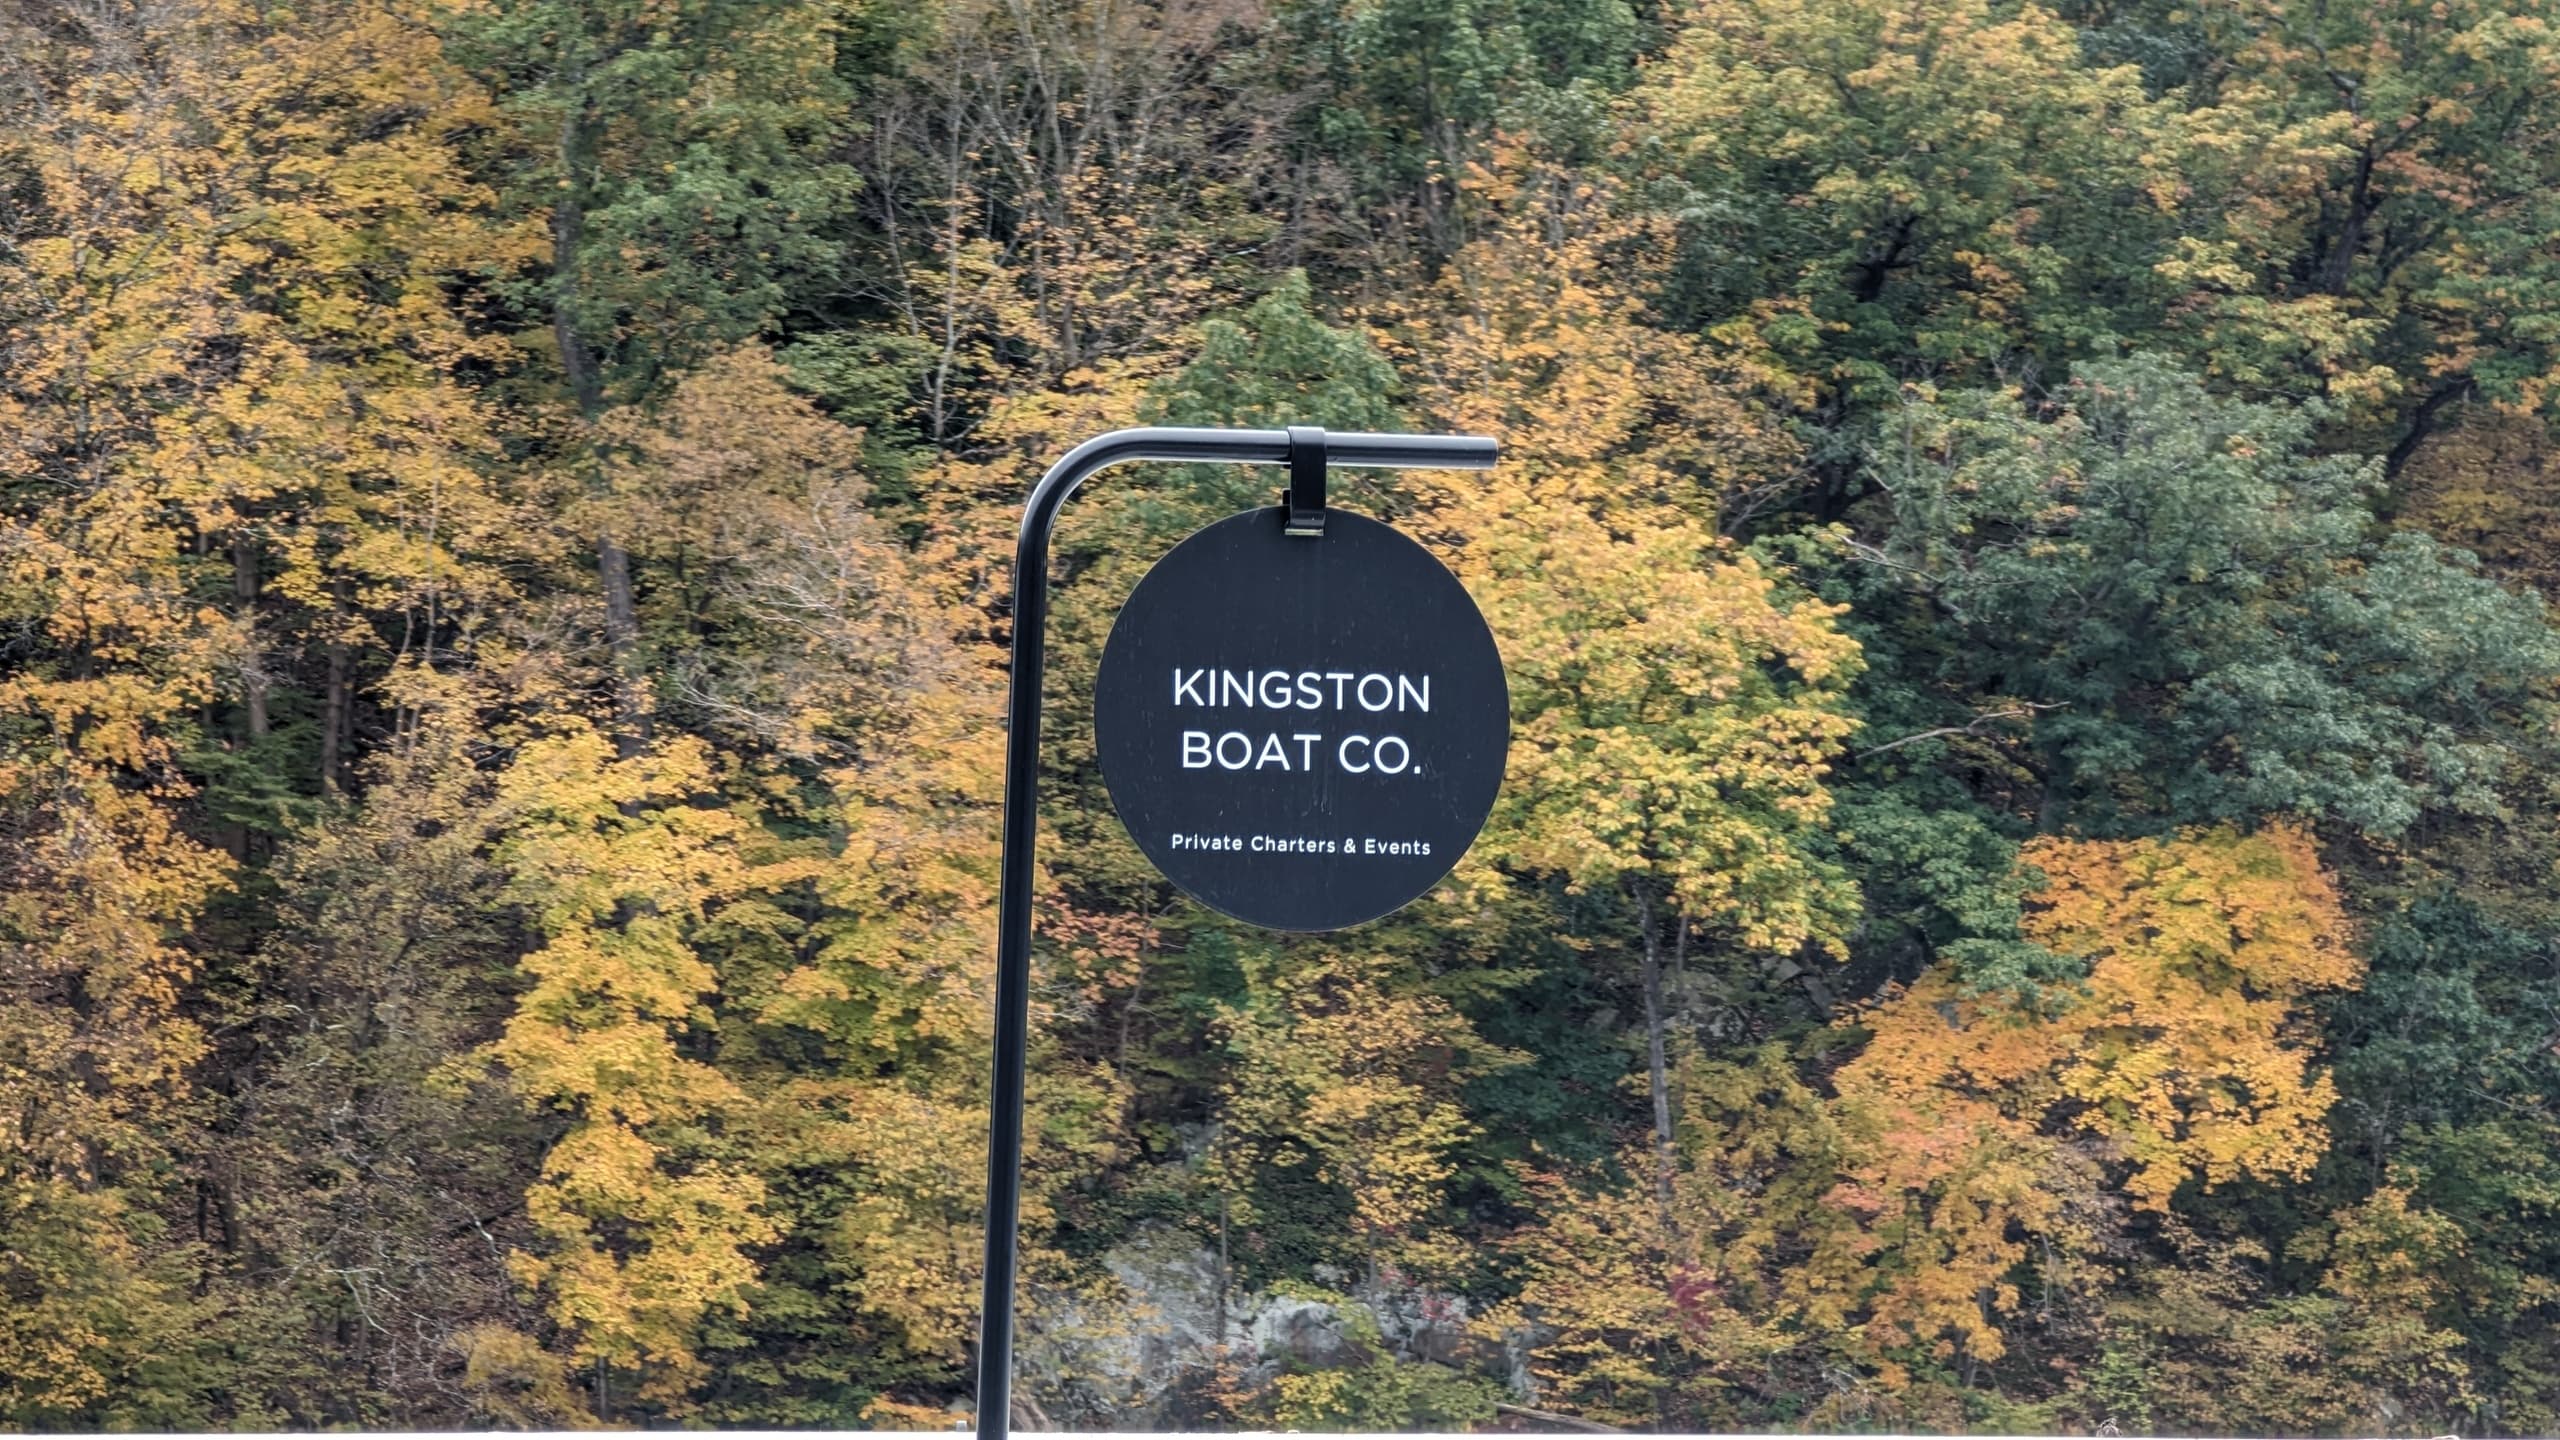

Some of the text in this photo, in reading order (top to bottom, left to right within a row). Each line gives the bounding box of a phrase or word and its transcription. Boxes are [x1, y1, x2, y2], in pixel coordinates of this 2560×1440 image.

[1173, 668, 1430, 712] KINGSTON
[1182, 730, 1421, 774] BOAT CO.
[1171, 833, 1431, 855] Private Charters & Events
